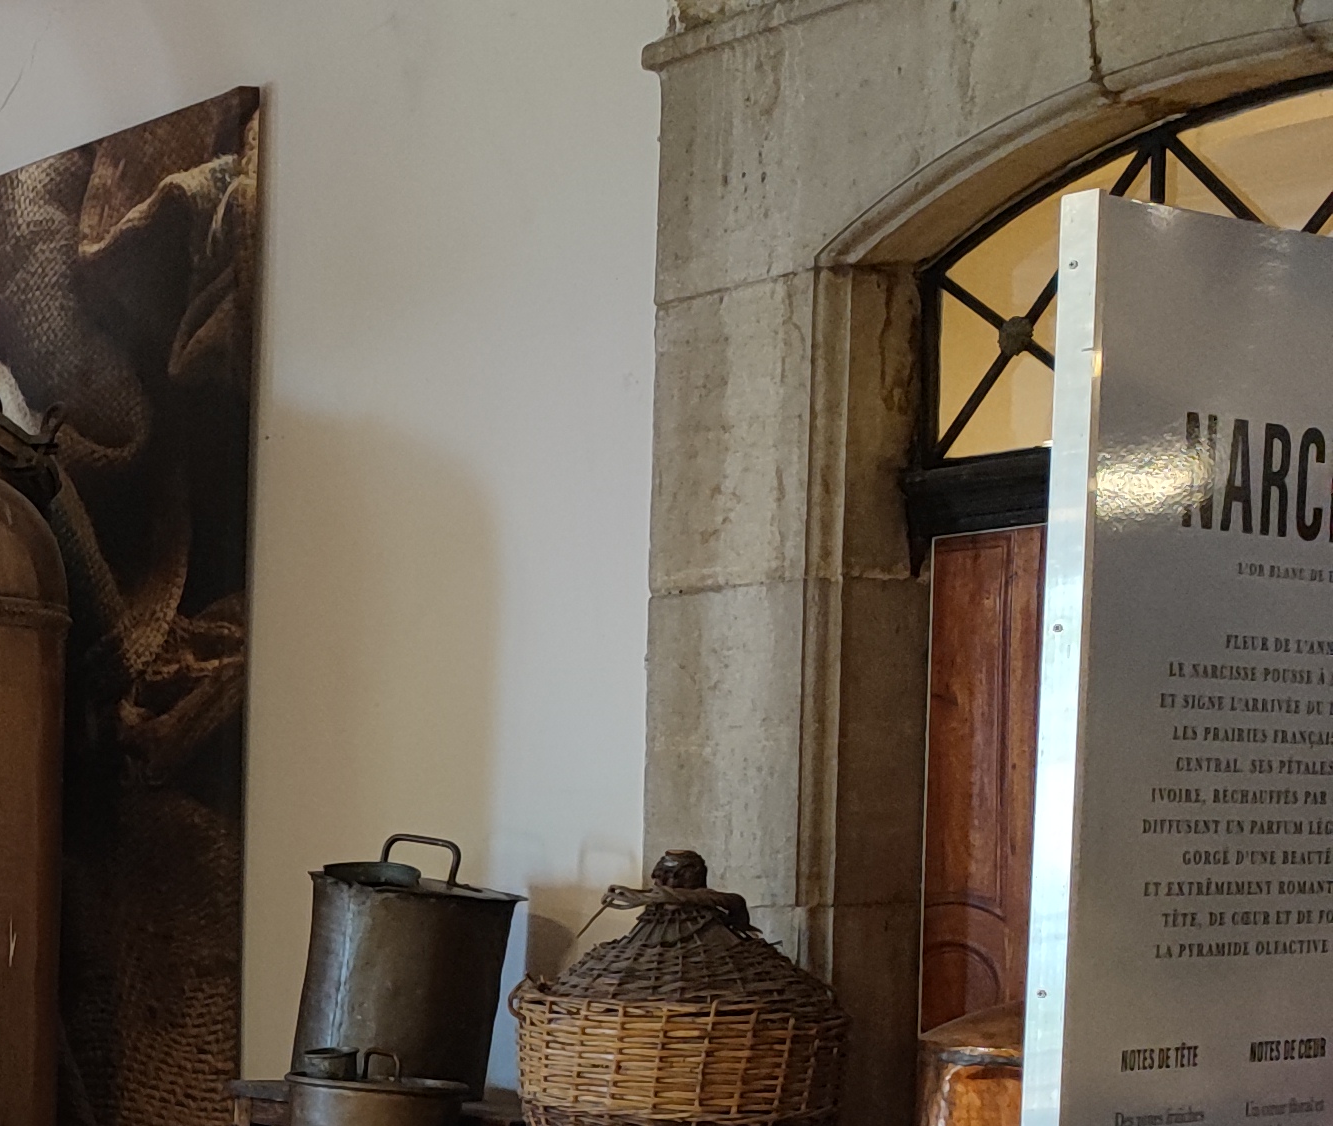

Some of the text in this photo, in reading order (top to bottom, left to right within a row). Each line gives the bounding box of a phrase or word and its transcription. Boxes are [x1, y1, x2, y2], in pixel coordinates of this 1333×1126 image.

[1269, 565, 1305, 581] BLANC
[1309, 568, 1324, 583] DE
[1225, 634, 1269, 652] FLEUR
[1274, 637, 1291, 653] DE
[1169, 661, 1185, 678] LE
[1190, 663, 1258, 682] NARCISSE
[1263, 667, 1313, 685] POUSSE
[1160, 693, 1324, 715] ET SIGNE L'ARRIVÉE DU
[1173, 725, 1198, 741] LES
[1203, 727, 1268, 743] PRAIRIES
[1249, 759, 1274, 775] SES
[1151, 786, 1328, 806] IVOIRE, RÉCHAUFFÉS PAR
[1142, 819, 1221, 835] DIFFUSENT
[1225, 819, 1245, 835] UN
[1249, 819, 1303, 836] PARFUM
[1182, 847, 1333, 866] GORGÉ D'UNE BEAUTÉ
[1143, 881, 1162, 897] ET
[1165, 877, 1273, 897] EXTRÊMEMENT
[1162, 909, 1202, 929] TÊTE,
[1208, 912, 1226, 927] DE
[1231, 910, 1271, 926] CŒUR
[1275, 910, 1293, 926] ET
[1295, 910, 1313, 925] DE
[1155, 939, 1329, 959] LA PYRAMIDE OLFACTIVE
[1121, 1042, 1199, 1072] NOTES DE TÊTE
[1249, 1037, 1327, 1062] NOTES DE CŒUR
[1245, 1101, 1260, 1117] Un
